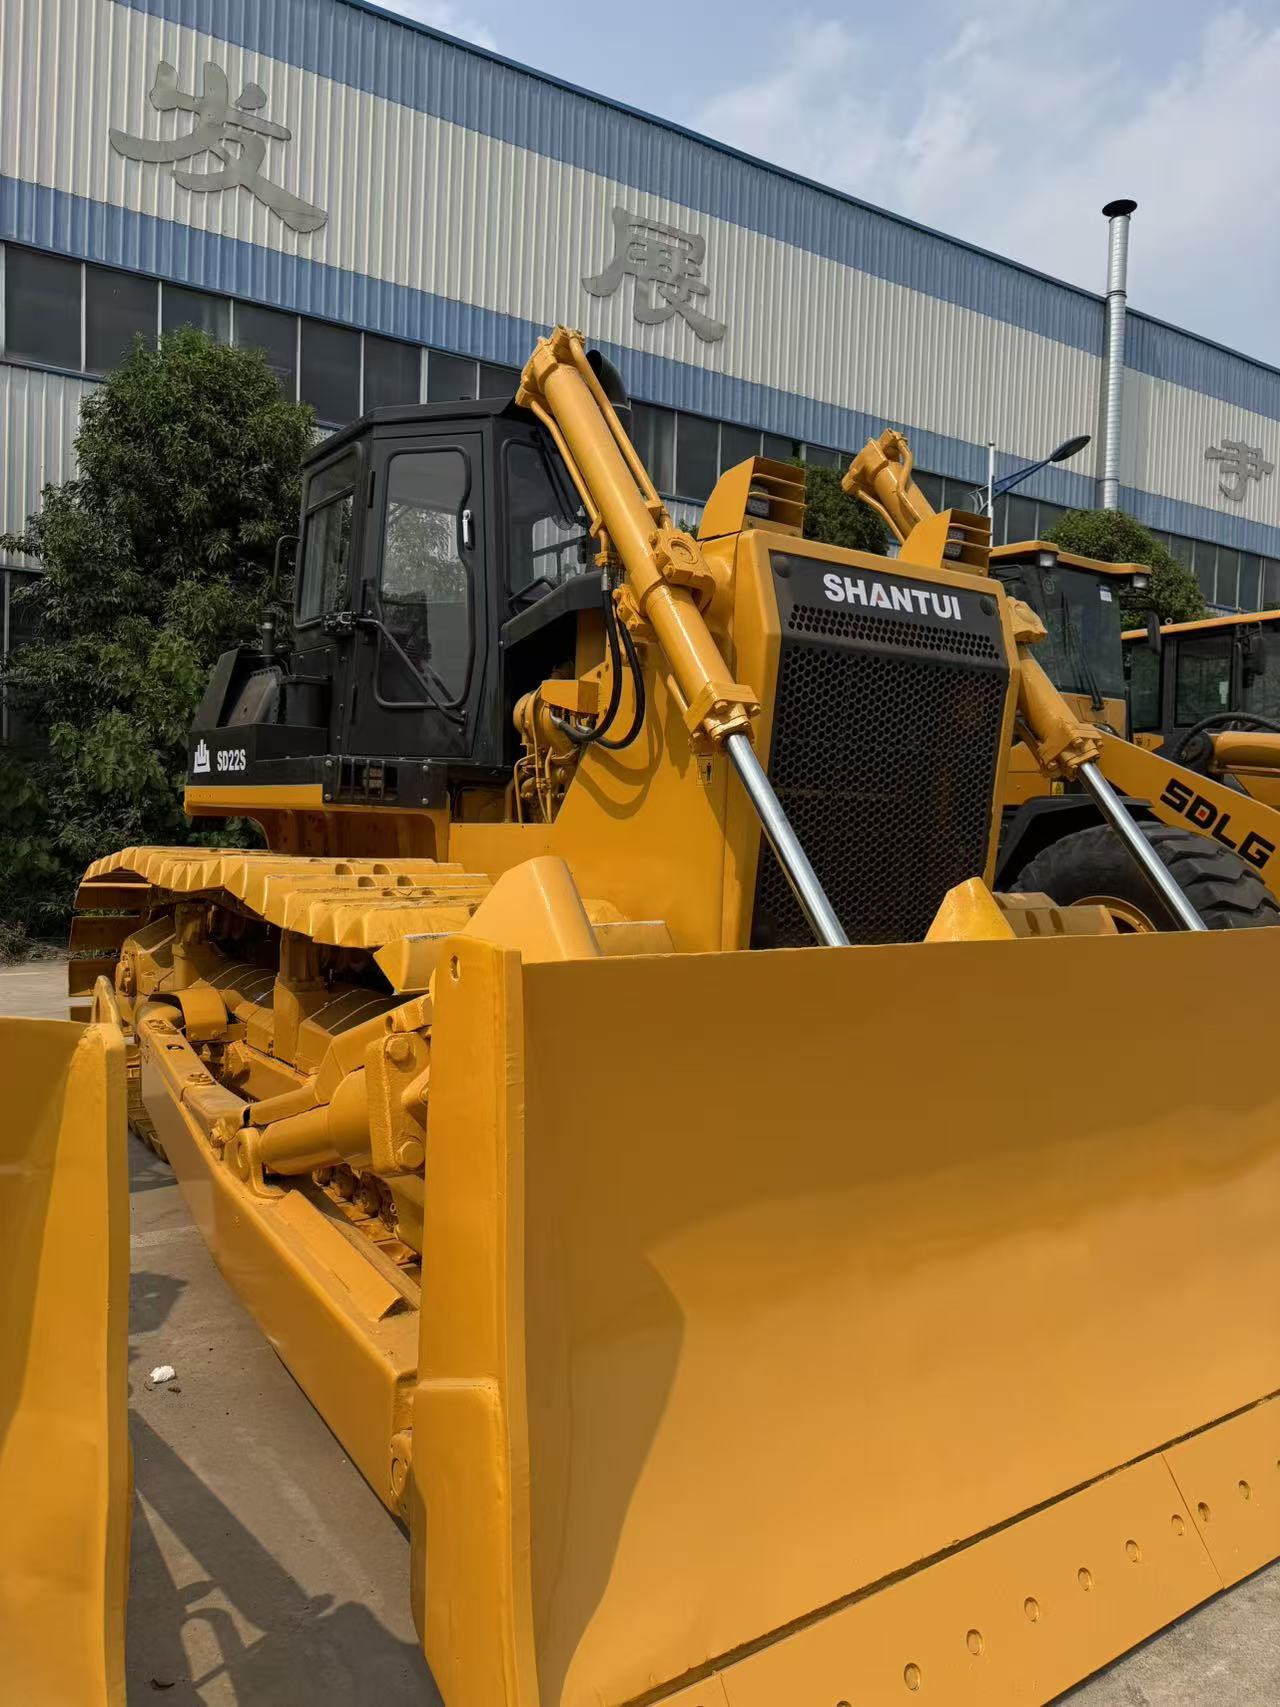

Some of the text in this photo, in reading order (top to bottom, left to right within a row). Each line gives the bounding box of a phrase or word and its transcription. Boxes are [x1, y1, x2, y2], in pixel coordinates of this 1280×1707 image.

[109, 60, 329, 234] 发
[581, 206, 728, 343] 展
[823, 573, 962, 620] SHANTUI
[216, 748, 247, 772] SD22S
[1160, 777, 1277, 870] SDLG
